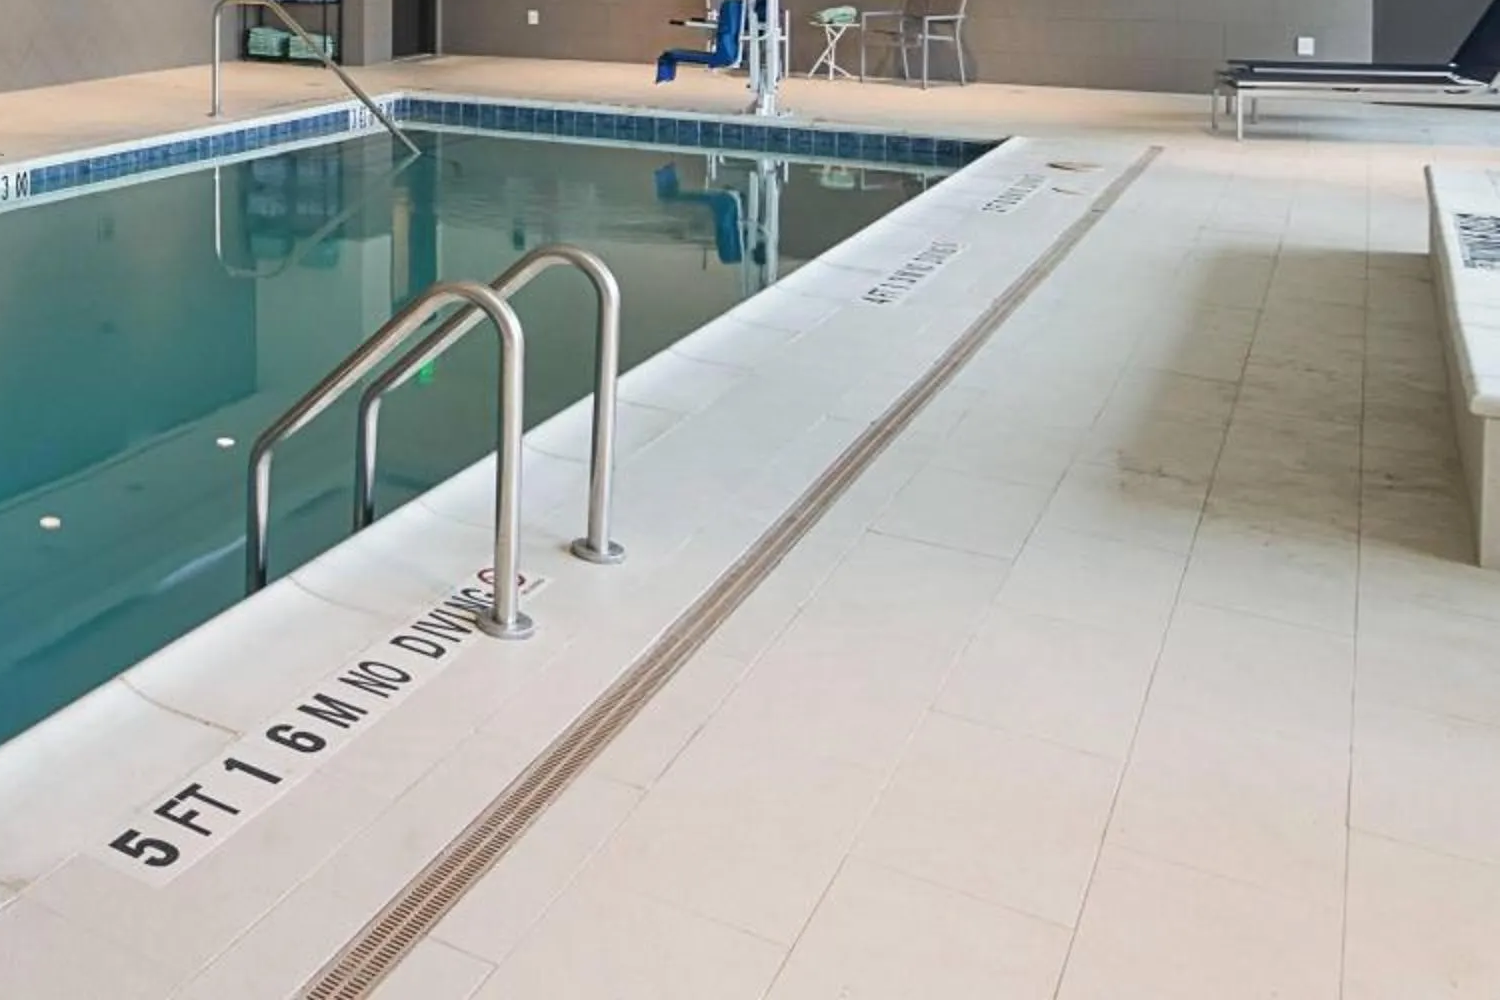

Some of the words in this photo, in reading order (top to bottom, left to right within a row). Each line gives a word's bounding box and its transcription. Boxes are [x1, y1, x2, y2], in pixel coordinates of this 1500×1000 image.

[389, 587, 495, 660] DIVING
[337, 660, 412, 699] NO
[296, 692, 369, 730] M
[265, 723, 328, 754] 6
[223, 756, 283, 786] 1
[153, 783, 241, 837] FT
[108, 828, 180, 868] 5
